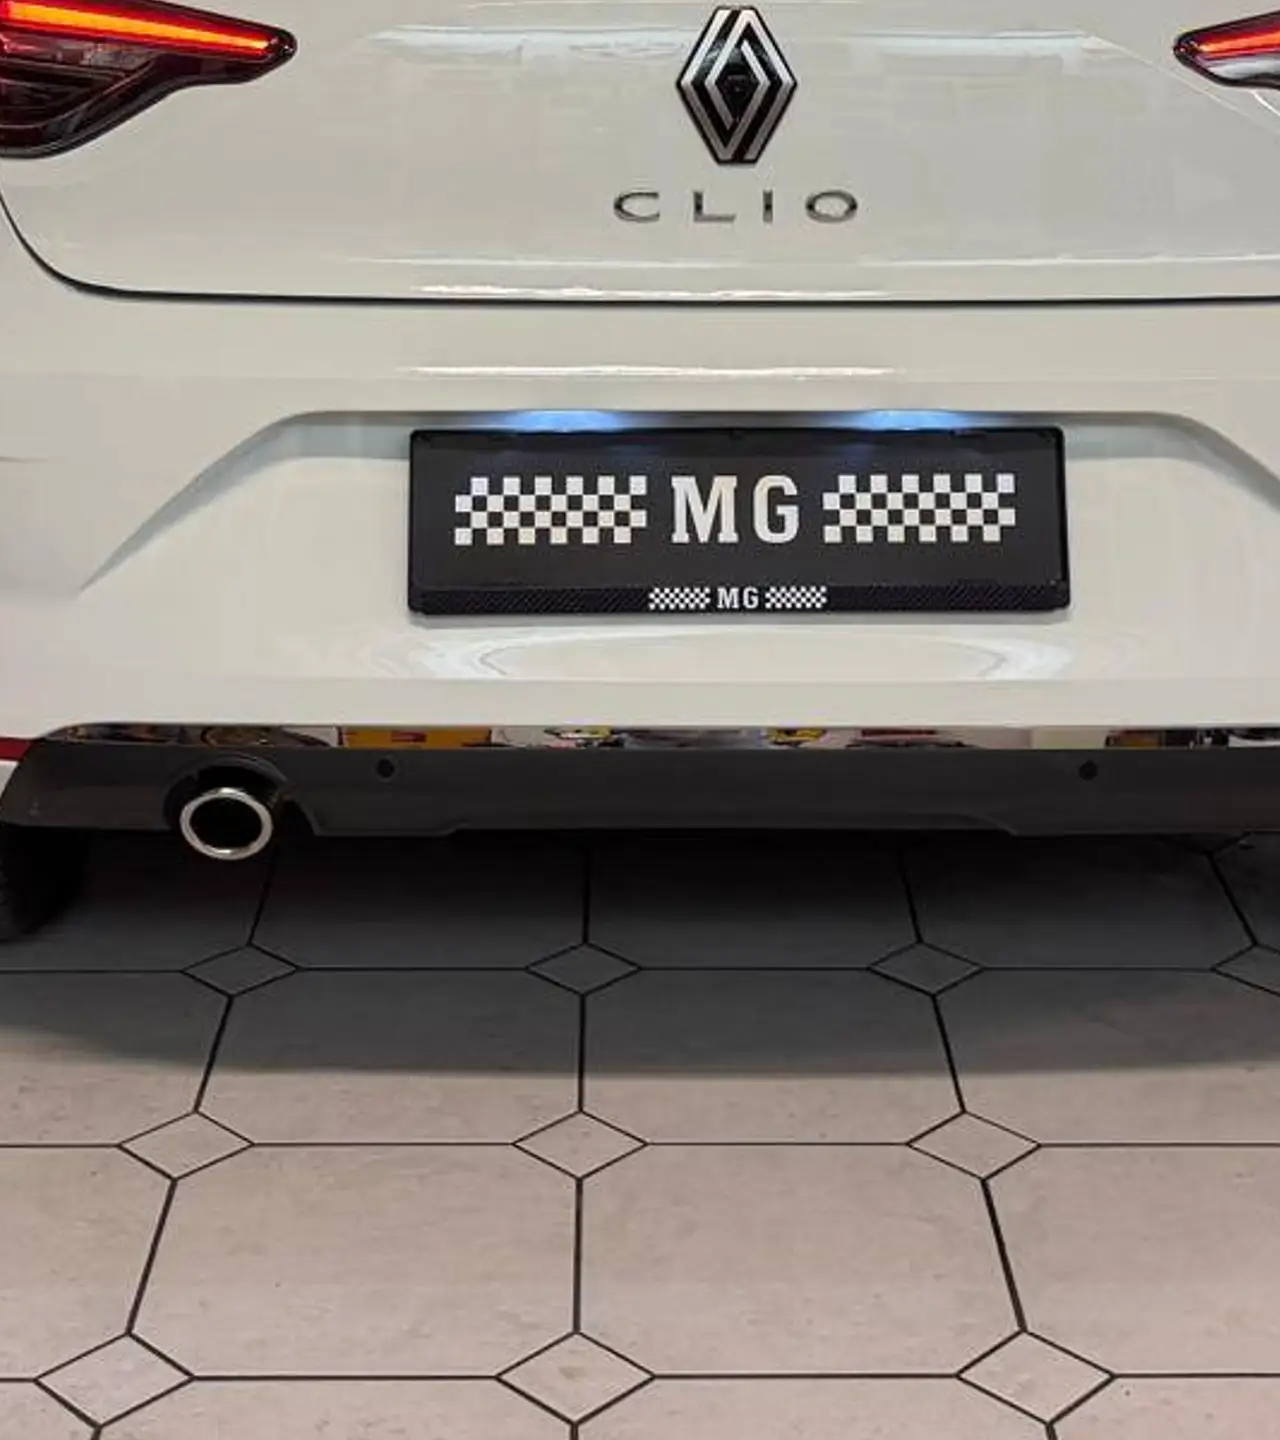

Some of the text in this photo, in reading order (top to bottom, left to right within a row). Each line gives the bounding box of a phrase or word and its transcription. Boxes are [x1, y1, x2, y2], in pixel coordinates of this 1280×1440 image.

[613, 189, 858, 224] CLIO
[670, 474, 800, 544] MG
[717, 586, 759, 609] MG
